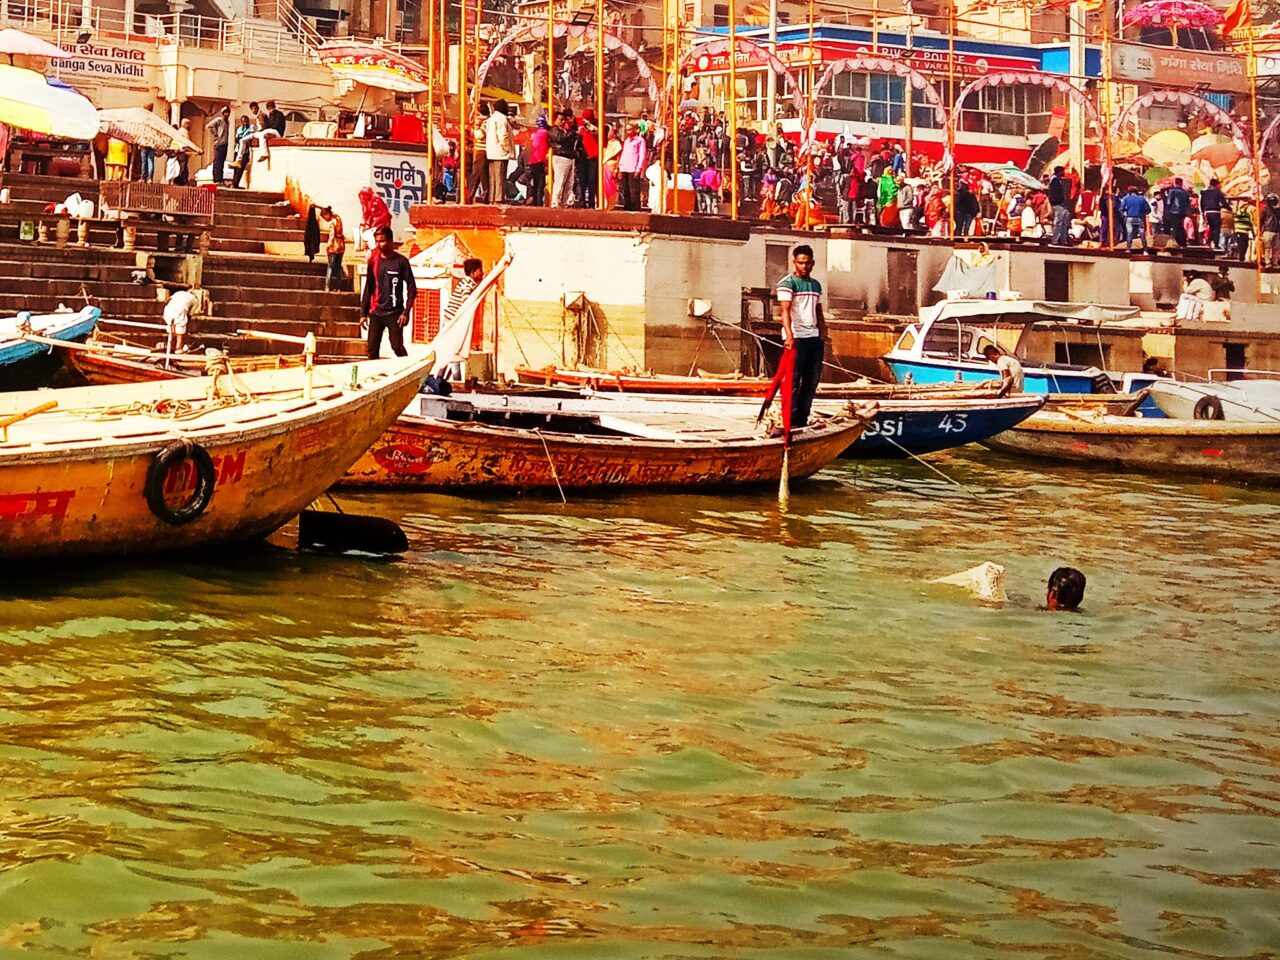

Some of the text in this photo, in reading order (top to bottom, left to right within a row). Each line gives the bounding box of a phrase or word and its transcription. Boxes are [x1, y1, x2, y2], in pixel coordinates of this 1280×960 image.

[57, 43, 146, 61] गा सेवा निधि
[50, 58, 145, 78] Ganga Seva Nidhi
[373, 160, 416, 185] नमामि
